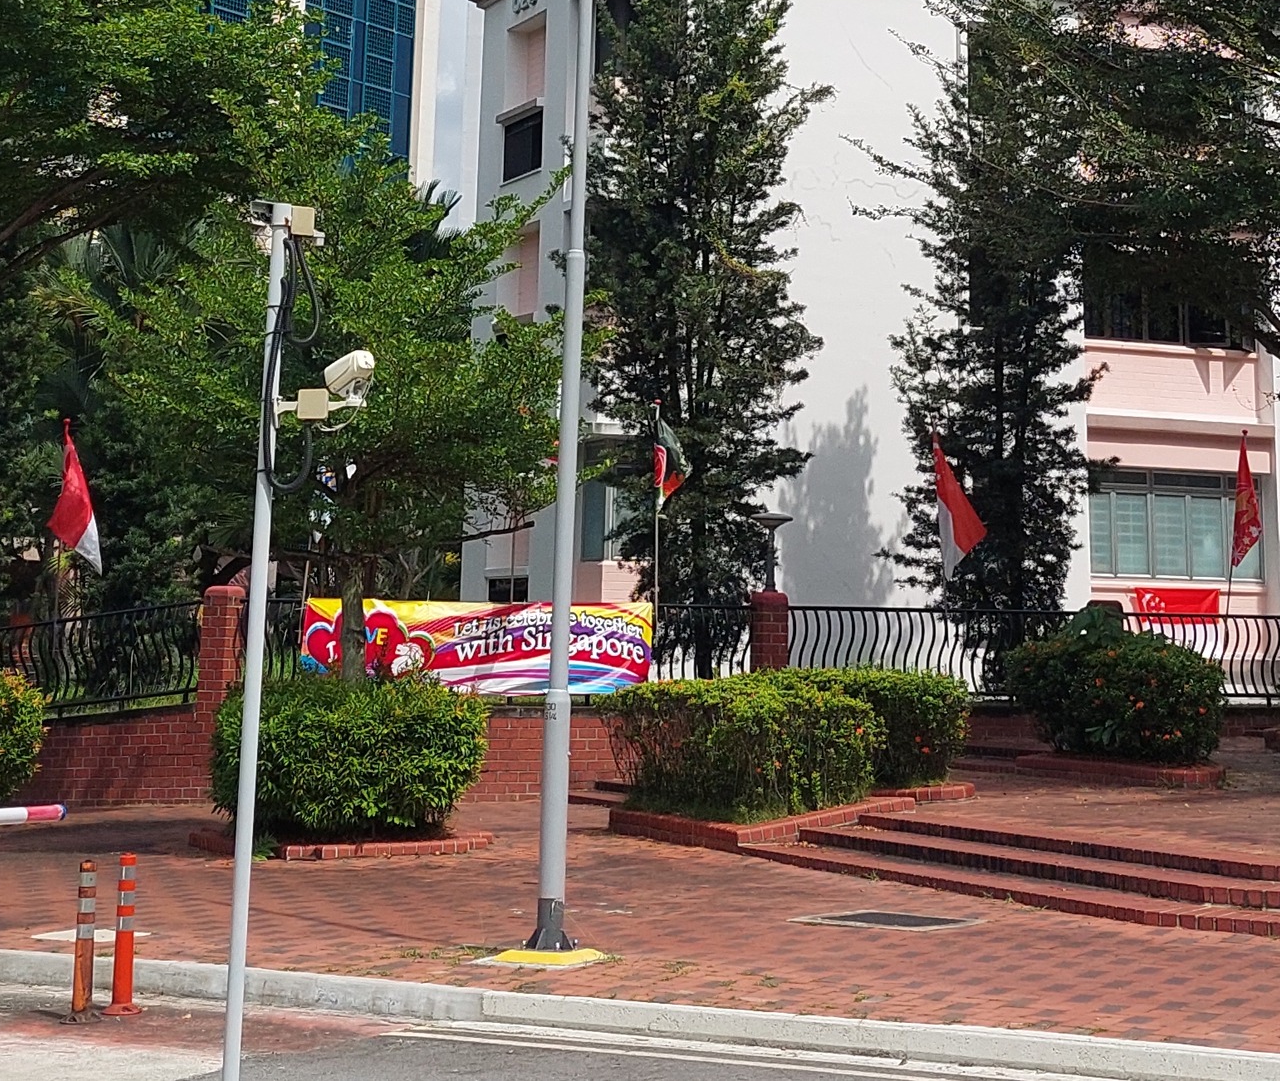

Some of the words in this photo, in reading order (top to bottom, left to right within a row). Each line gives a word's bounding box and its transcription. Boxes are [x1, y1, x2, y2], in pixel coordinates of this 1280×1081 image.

[454, 619, 479, 638] Let
[506, 609, 578, 628] celebre
[581, 612, 643, 639] together
[454, 628, 514, 662] with
